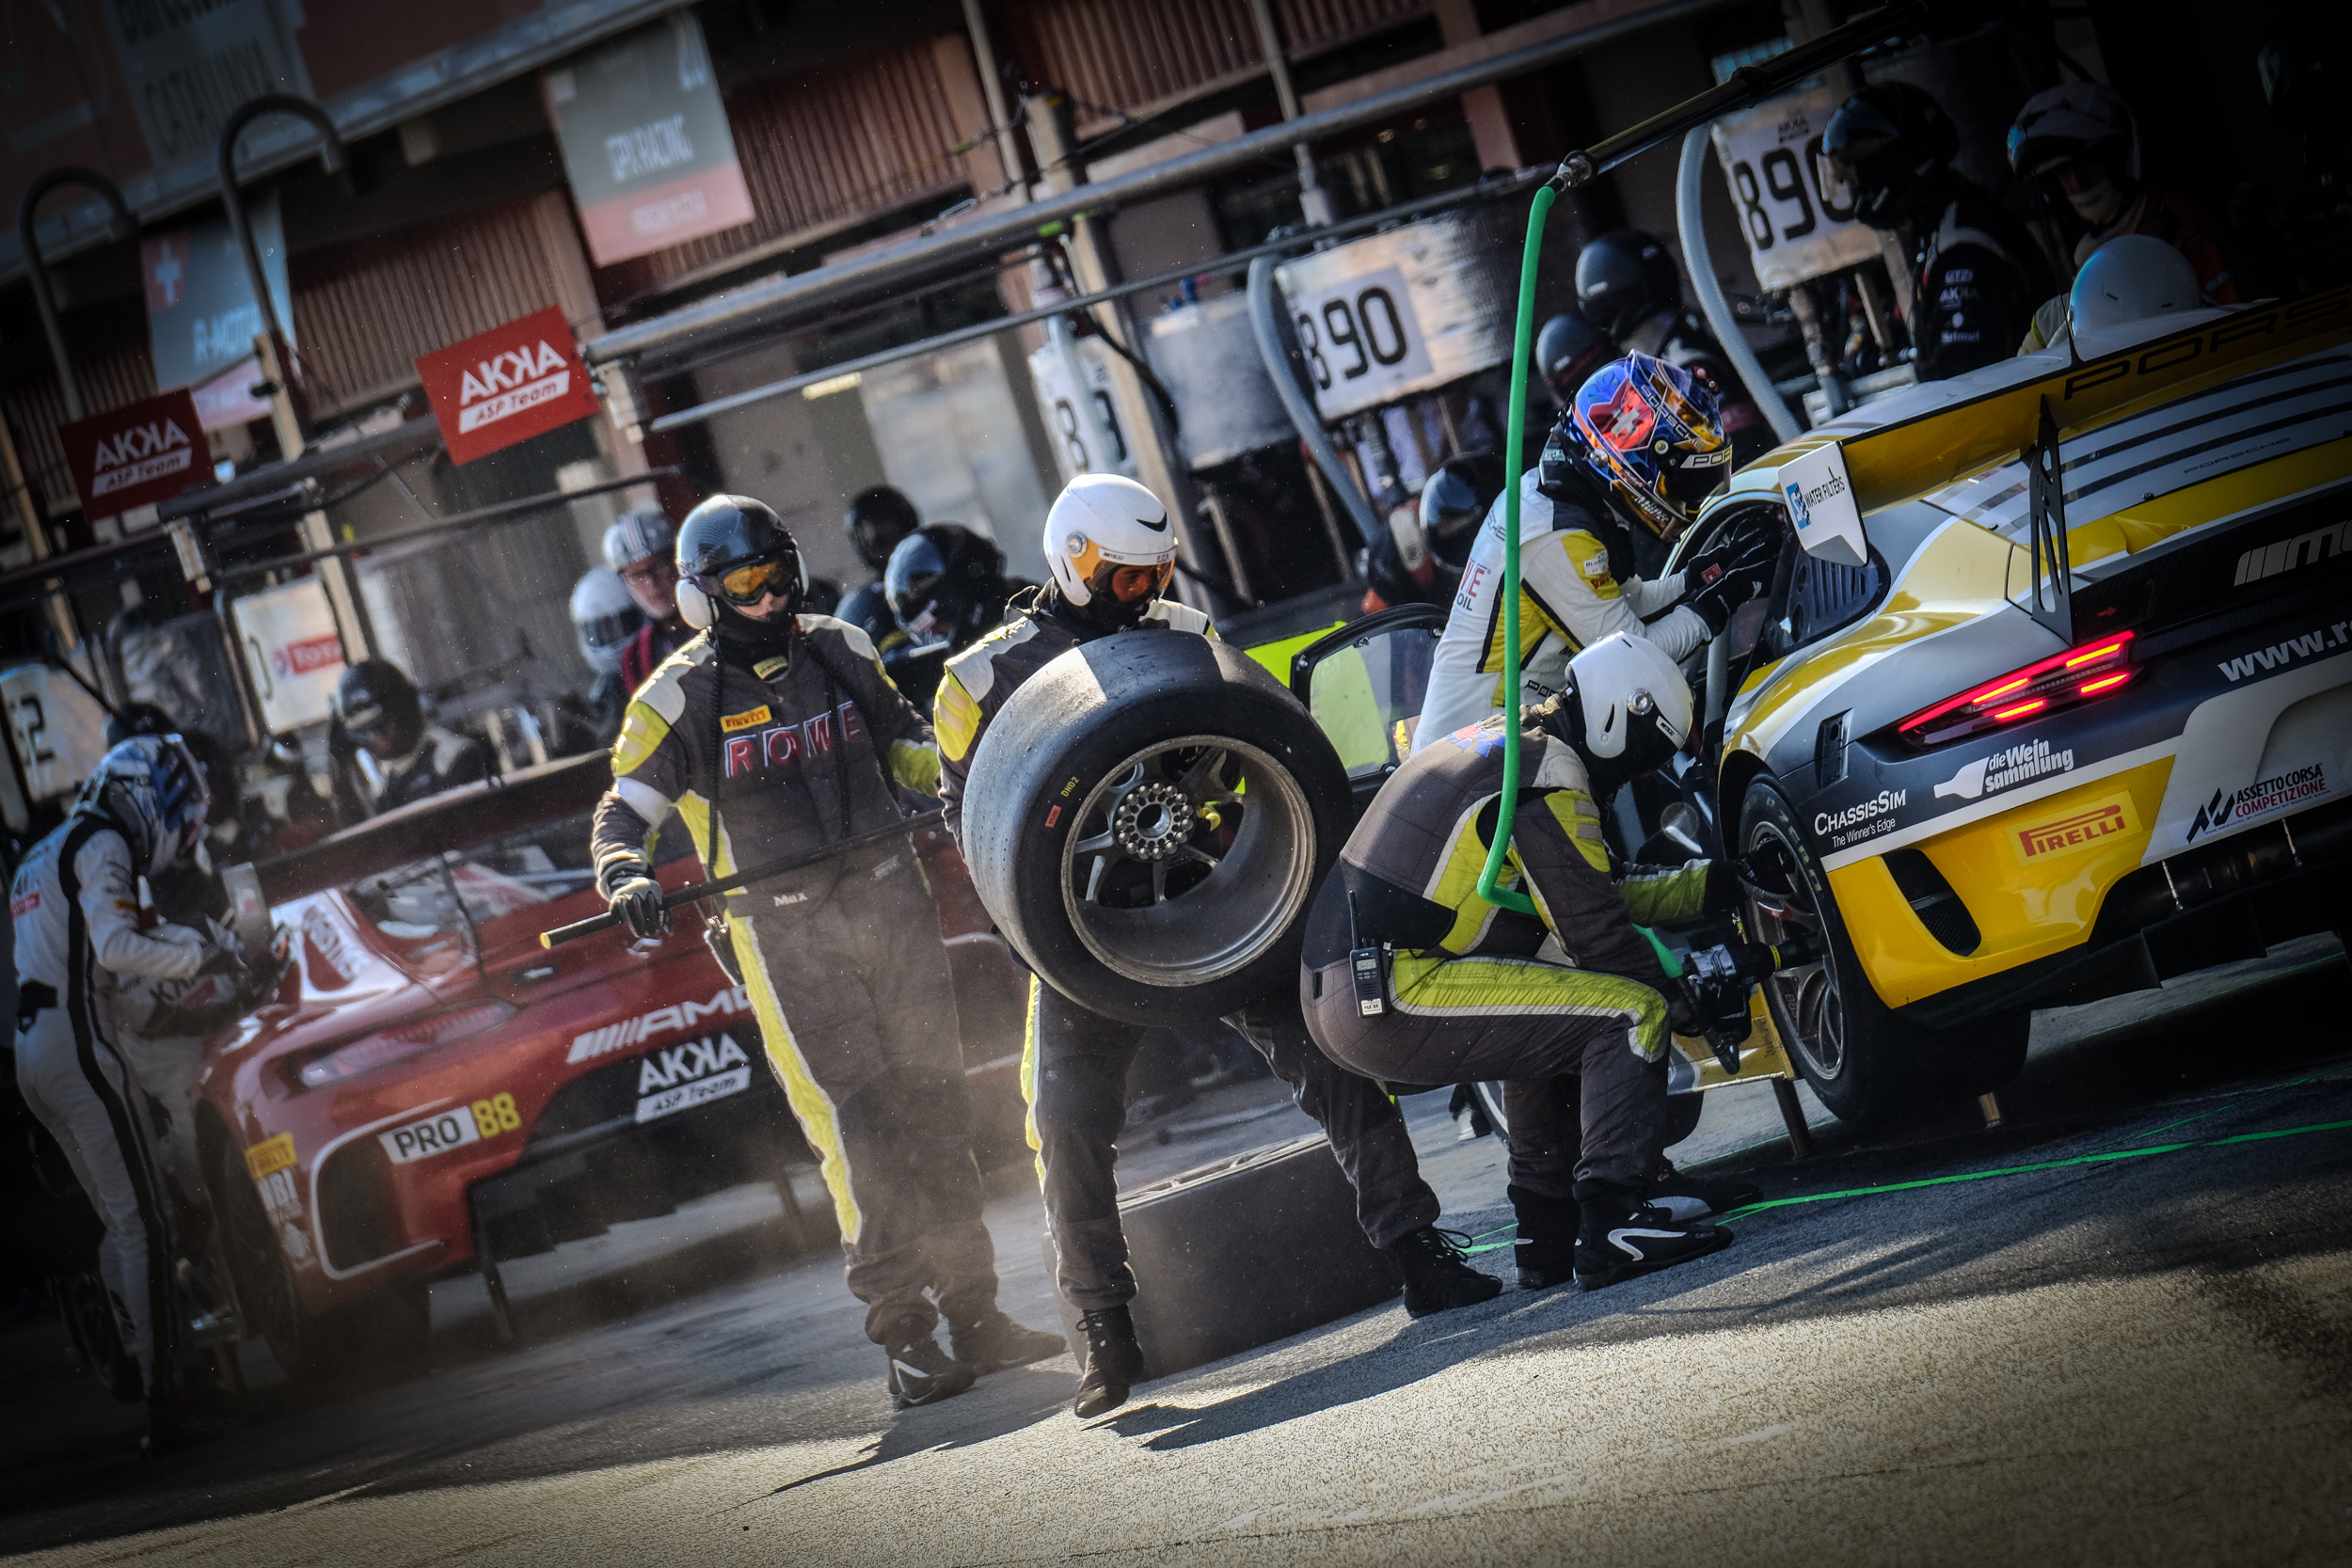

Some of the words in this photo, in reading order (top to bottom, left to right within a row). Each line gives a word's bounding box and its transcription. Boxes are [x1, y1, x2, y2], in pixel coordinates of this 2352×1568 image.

[2064, 288, 2351, 402] PORS
[460, 339, 568, 405] AKKA
[475, 399, 506, 422] ASP
[509, 382, 557, 410] Team
[94, 417, 191, 473] AKKA
[2184, 437, 2291, 474] PORSCHE
[1804, 486, 1822, 509] WATER
[1821, 476, 1846, 499] FILTERS
[1456, 593, 1472, 611] OIL
[724, 701, 861, 779] ROWE
[1988, 753, 2007, 772] die
[2005, 738, 2050, 767] Wein
[1985, 749, 2074, 793] sammlung
[2236, 776, 2284, 804] ASSETTO
[2285, 763, 2324, 787] CORSA
[2235, 778, 2327, 818] COMPETIZIONE
[1832, 834, 1846, 848] The
[1846, 823, 1876, 844] Winner's
[1877, 816, 1896, 832] Edge
[2018, 804, 2125, 858] PIRELLI
[773, 893, 808, 908] Max
[638, 1032, 751, 1095] AKKA
[393, 1117, 461, 1159] PRO
[471, 1092, 522, 1140] 88
